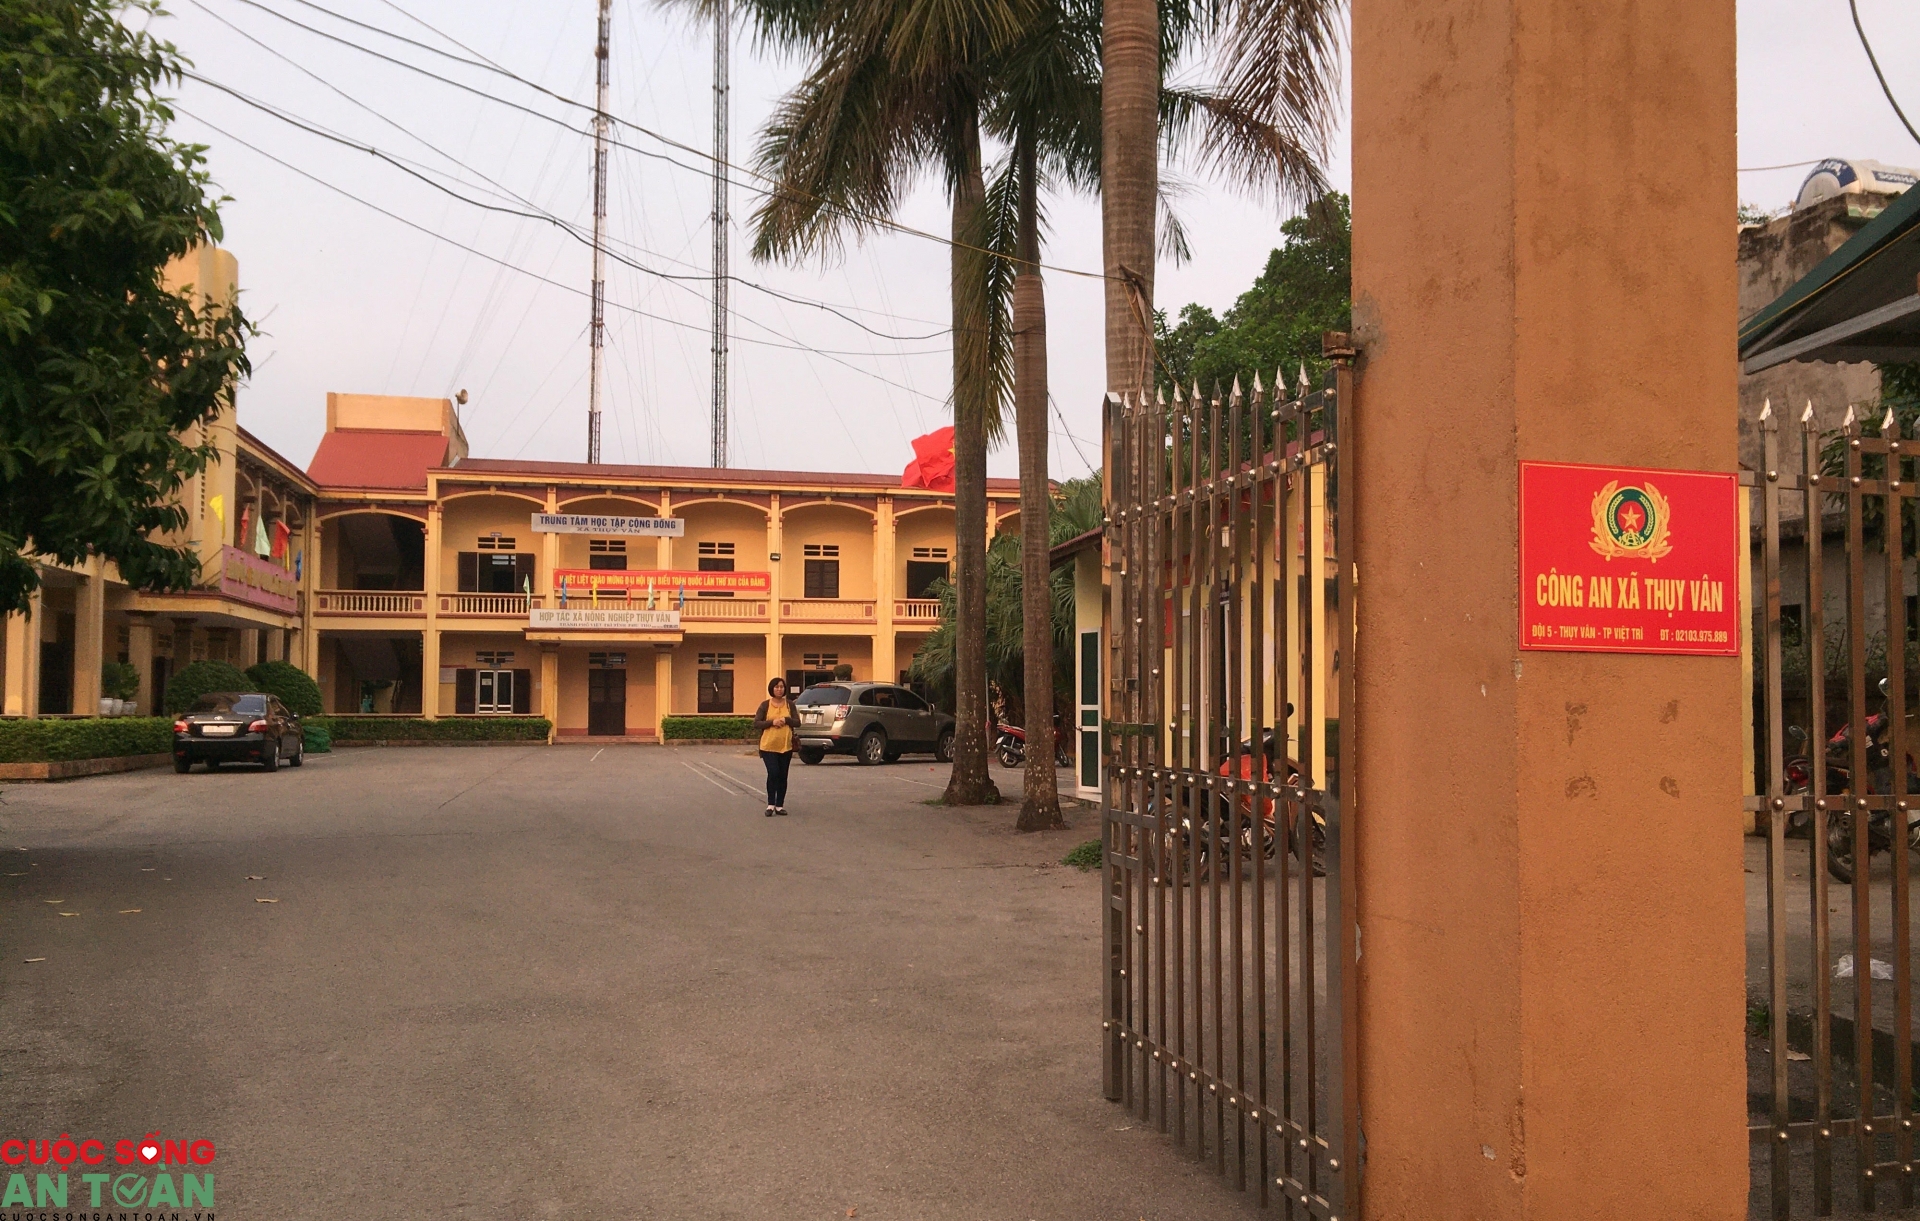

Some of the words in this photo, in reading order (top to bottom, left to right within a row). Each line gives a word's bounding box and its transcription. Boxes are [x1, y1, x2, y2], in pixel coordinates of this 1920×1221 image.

[540, 516, 568, 525] TRUNG
[570, 516, 588, 526] TÂM
[590, 518, 607, 528] HỌC
[610, 517, 625, 529] TẬP
[628, 518, 650, 529] CỘNG
[654, 518, 676, 529] ĐỒNG
[577, 574, 589, 586] LIỆT
[590, 574, 606, 585] CHÀO
[607, 574, 624, 585] MỪNG
[672, 575, 686, 586] TOÀN
[688, 575, 702, 586] QUỐC
[1536, 567, 1583, 607] CÔNG
[1588, 576, 1612, 608] AN
[1617, 571, 1640, 610] XÃ
[1644, 578, 1685, 617] THỤY
[1690, 574, 1722, 612] VÂN
[540, 611, 554, 622] HỢP
[556, 611, 570, 622] TÁC
[573, 611, 582, 622] XÃ
[585, 611, 605, 622] NÔNG
[608, 612, 635, 624] NGHIỆP
[636, 613, 654, 624] THỤY
[656, 612, 670, 622] VÂN
[1532, 622, 1545, 640] ĐỘI
[1547, 626, 1552, 638] 5
[1559, 626, 1578, 640] THỤY
[1580, 624, 1596, 638] VÂN
[1603, 627, 1612, 639] TP
[1614, 625, 1630, 642] VIỆT
[1631, 626, 1644, 640] TRÌ
[1660, 629, 1670, 640] ĐT
[1675, 630, 1728, 642] 02103.975.889
